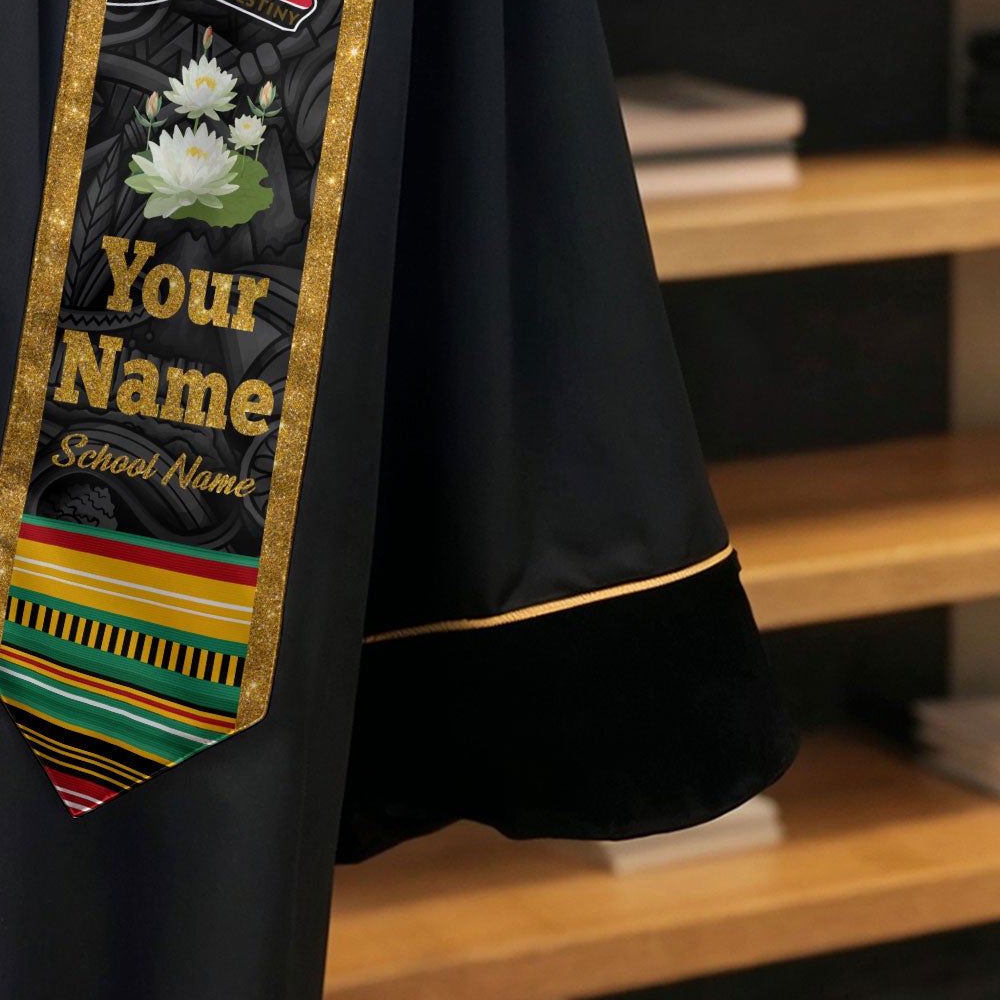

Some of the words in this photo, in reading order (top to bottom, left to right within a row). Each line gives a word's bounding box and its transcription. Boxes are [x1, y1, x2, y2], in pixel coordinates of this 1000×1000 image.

[102, 235, 270, 333] Your
[53, 328, 275, 437] Name
[52, 433, 161, 480] School
[160, 452, 256, 498] Name
